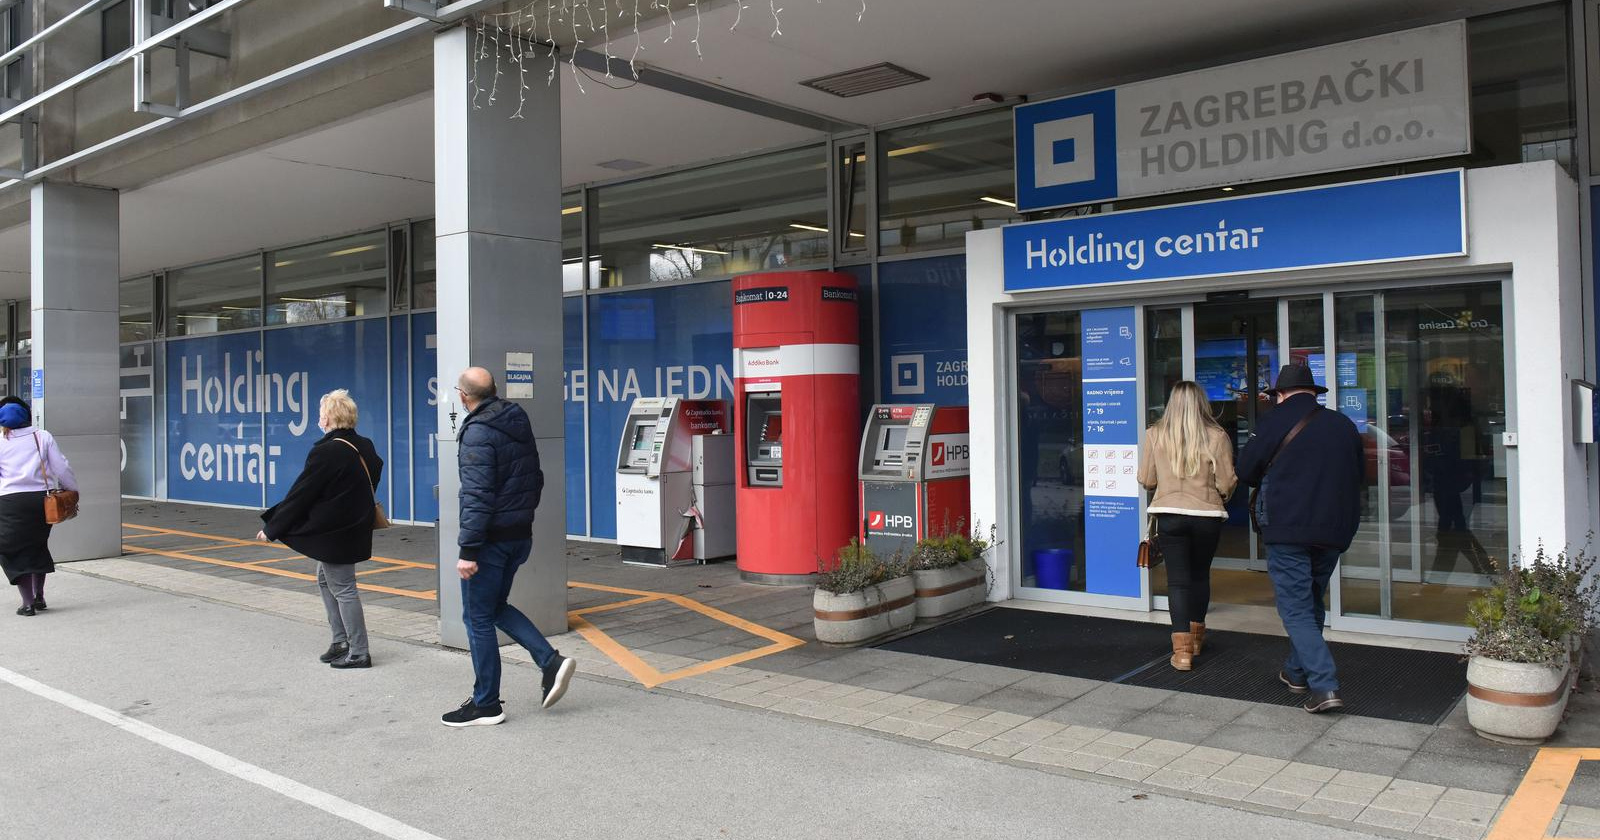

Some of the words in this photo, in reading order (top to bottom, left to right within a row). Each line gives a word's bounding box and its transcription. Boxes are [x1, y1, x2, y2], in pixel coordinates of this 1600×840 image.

[1140, 58, 1425, 137] ZAGREBAČKI
[1140, 119, 1329, 178] HOLDING
[1341, 119, 1435, 150] d.o.o.
[1026, 232, 1145, 271] Holding
[1155, 219, 1264, 258] centar
[181, 350, 309, 437] Holding
[597, 368, 643, 403] NA
[690, 421, 720, 430] bankomat
[180, 420, 282, 485] centar
[946, 444, 970, 461] HPB
[885, 515, 914, 529] HPB
